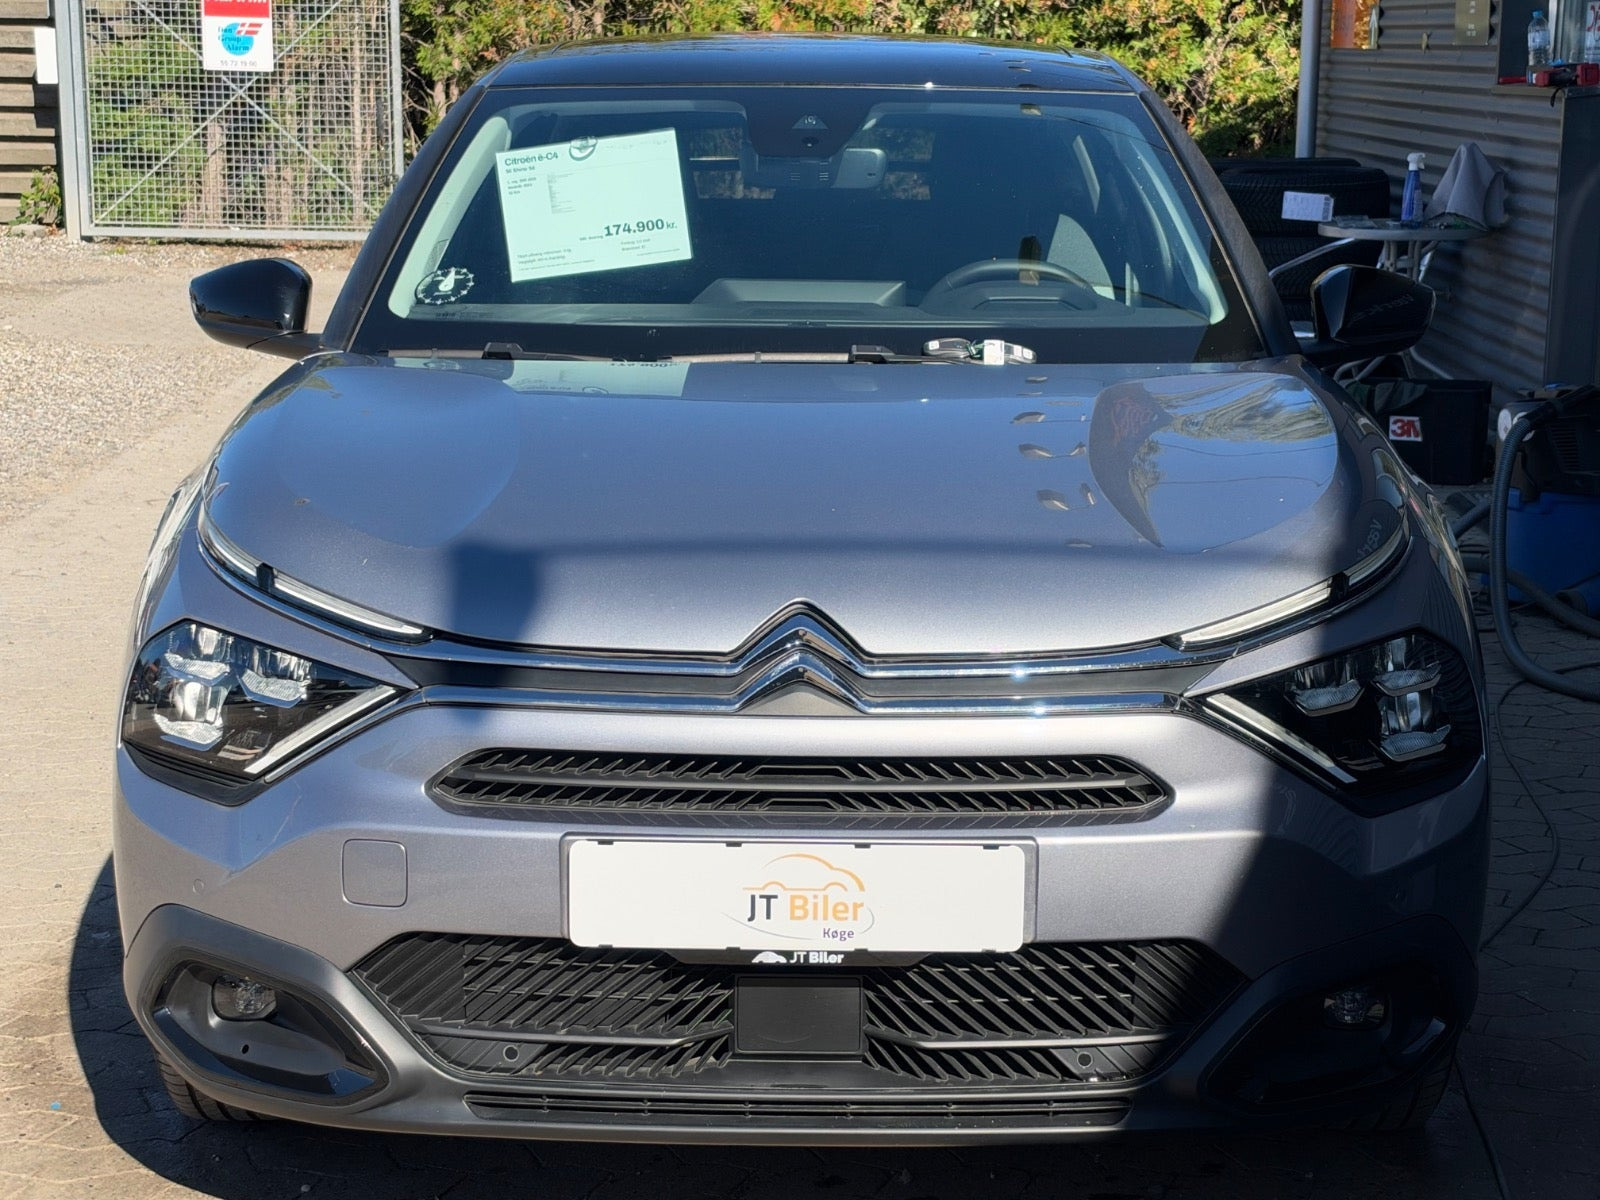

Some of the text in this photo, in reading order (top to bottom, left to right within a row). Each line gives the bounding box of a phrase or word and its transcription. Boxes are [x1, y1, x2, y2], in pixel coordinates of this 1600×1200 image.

[227, 43, 249, 51] Alarm
[604, 218, 678, 237] 174.900 kr.
[1391, 418, 1419, 438] 3M
[747, 894, 864, 922] JT Biler
[823, 927, 855, 942] Køge
[790, 951, 845, 964] JT Biler
